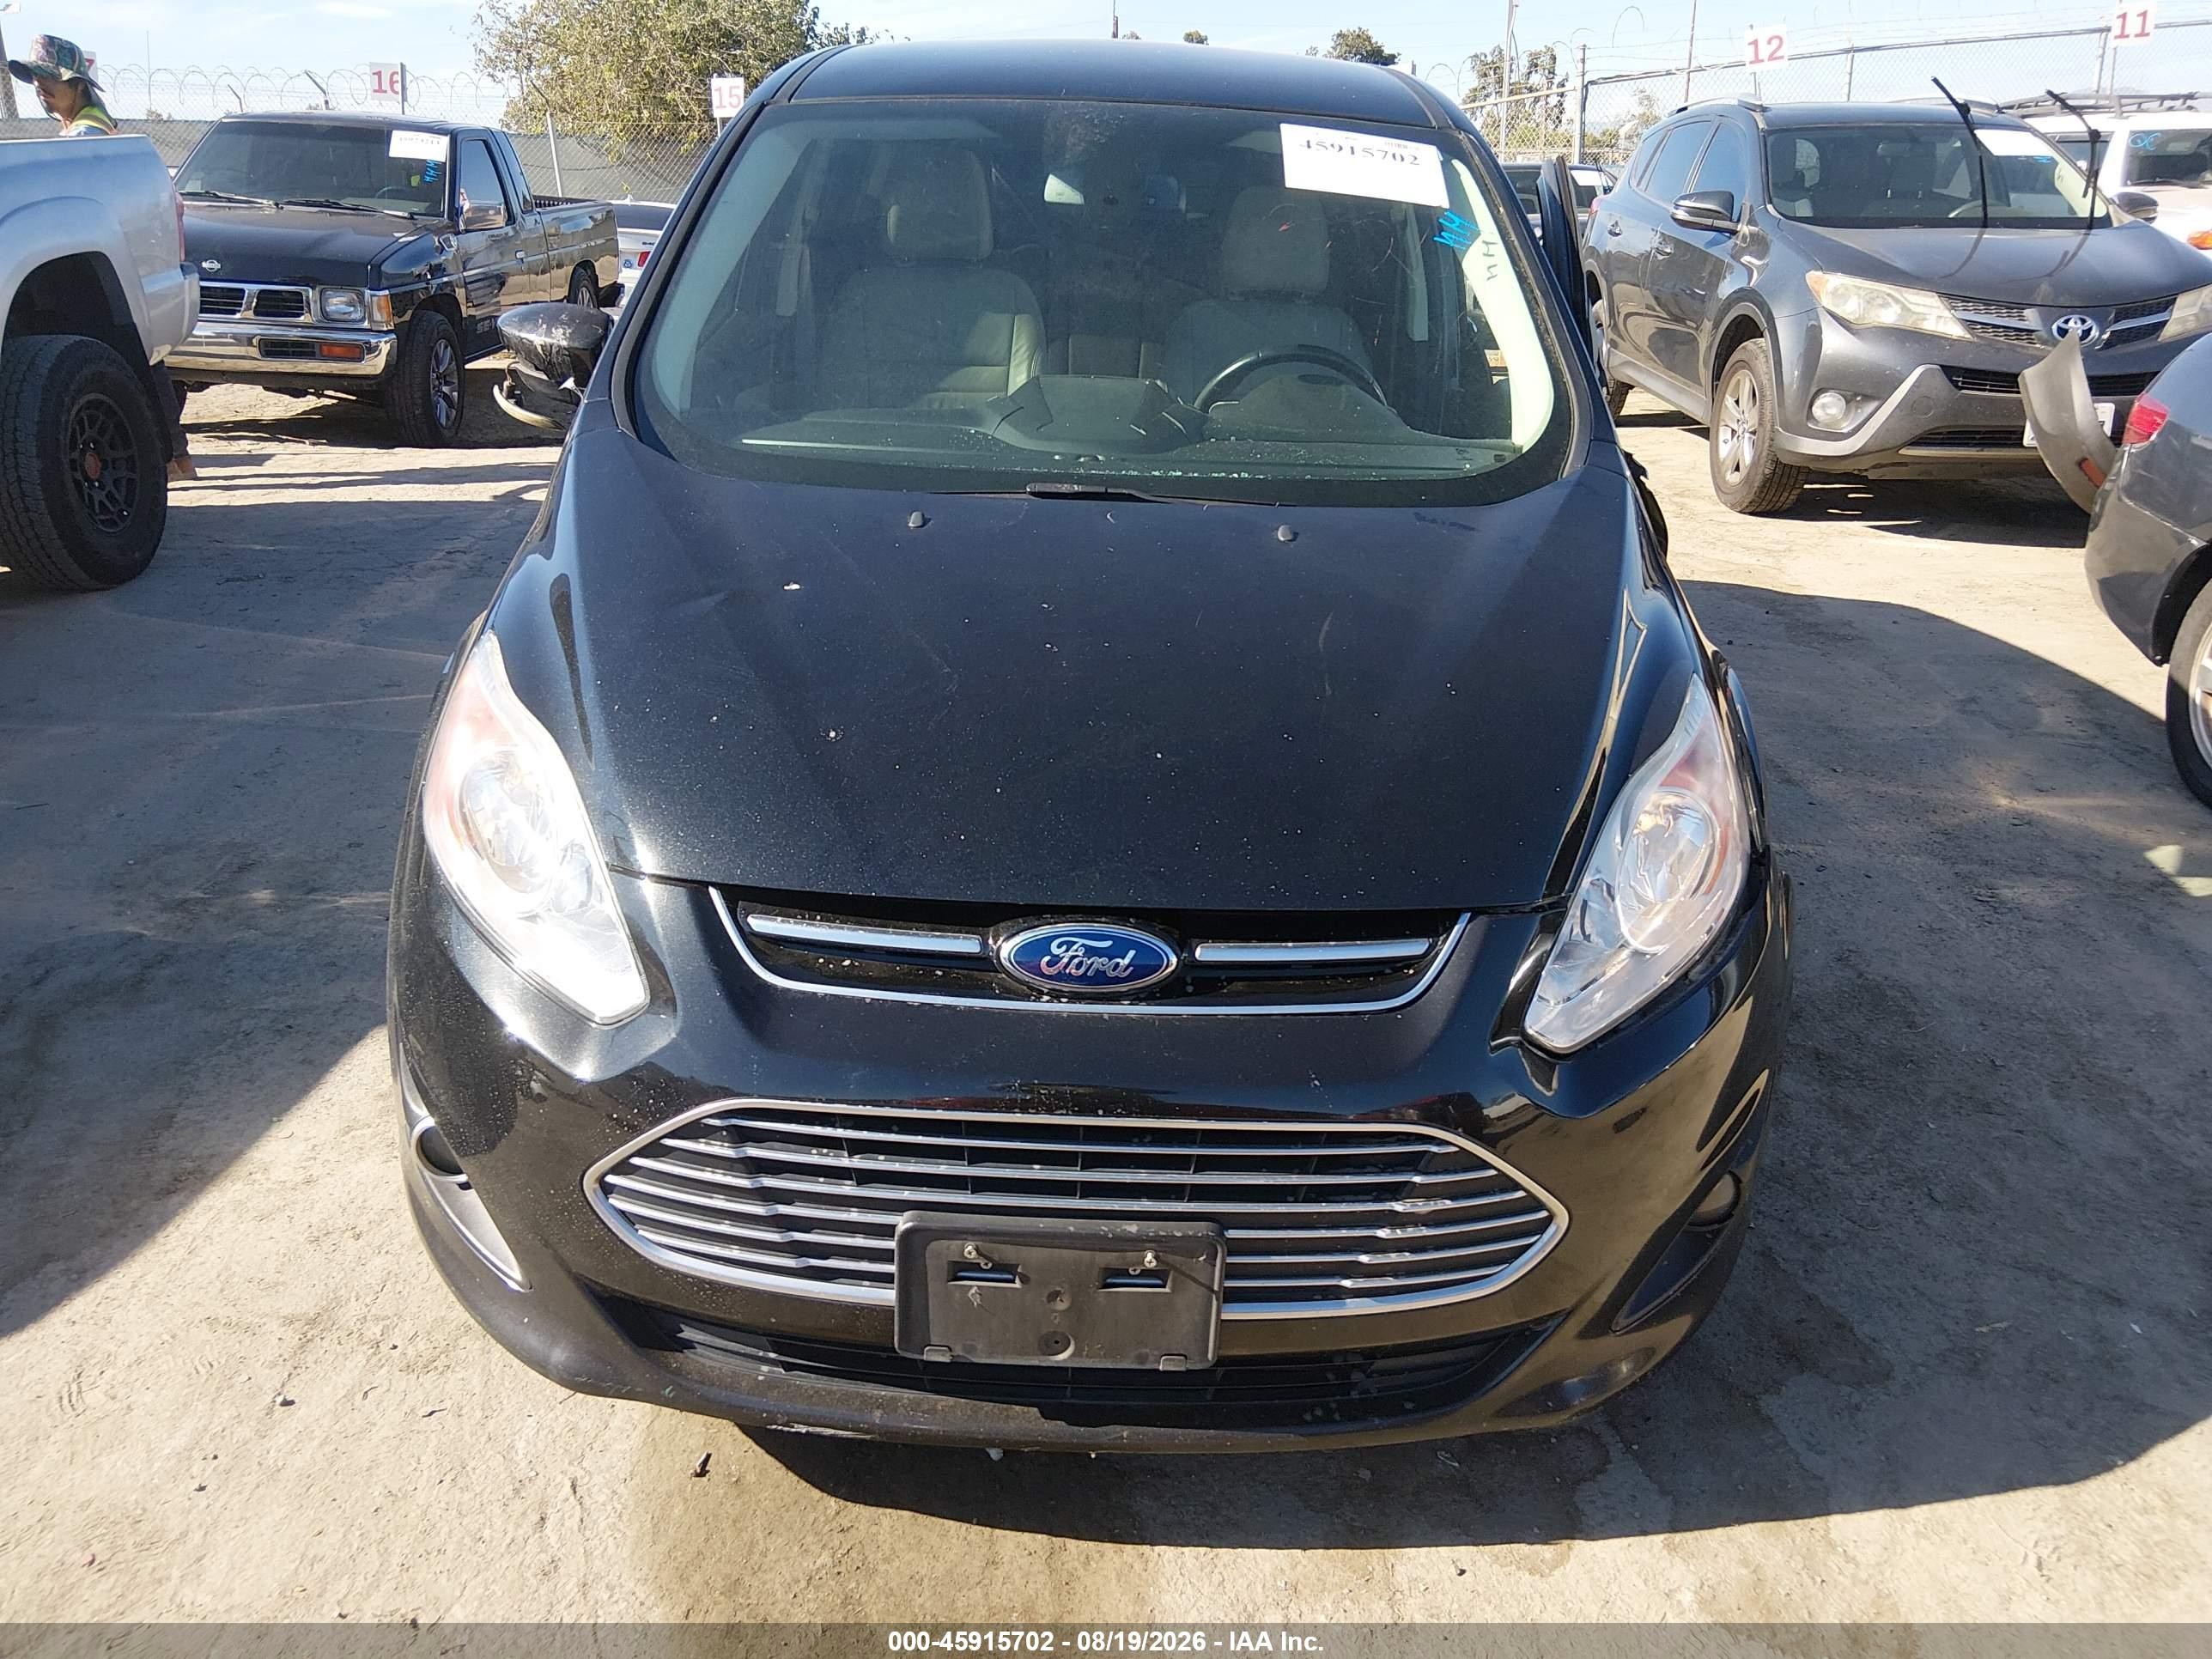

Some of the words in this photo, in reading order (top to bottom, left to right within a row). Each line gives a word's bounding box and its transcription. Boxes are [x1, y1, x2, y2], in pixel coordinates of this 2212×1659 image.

[2114, 9, 2150, 40] 11
[1747, 35, 1784, 64] 12
[714, 86, 741, 109] 15
[1040, 937, 1136, 977] Ford
